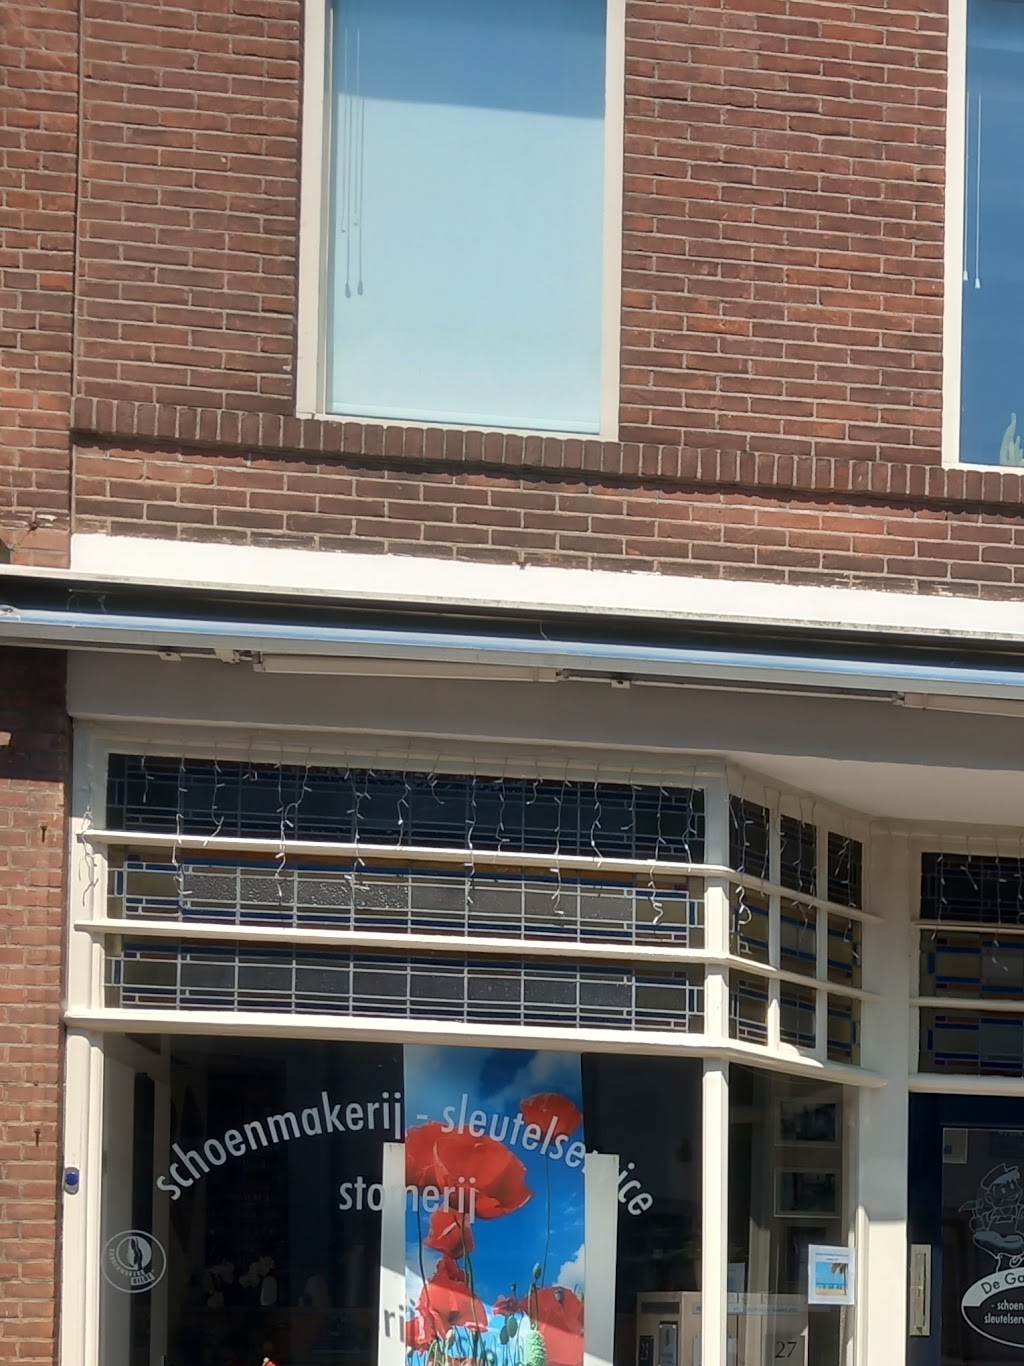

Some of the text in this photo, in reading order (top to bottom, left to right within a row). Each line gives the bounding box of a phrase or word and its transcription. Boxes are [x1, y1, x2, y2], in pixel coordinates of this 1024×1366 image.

[156, 1090, 402, 1200] schoenmakerij
[440, 1093, 654, 1216] sleutelseice
[981, 1280, 1000, 1295] De
[775, 1341, 797, 1358] 27
